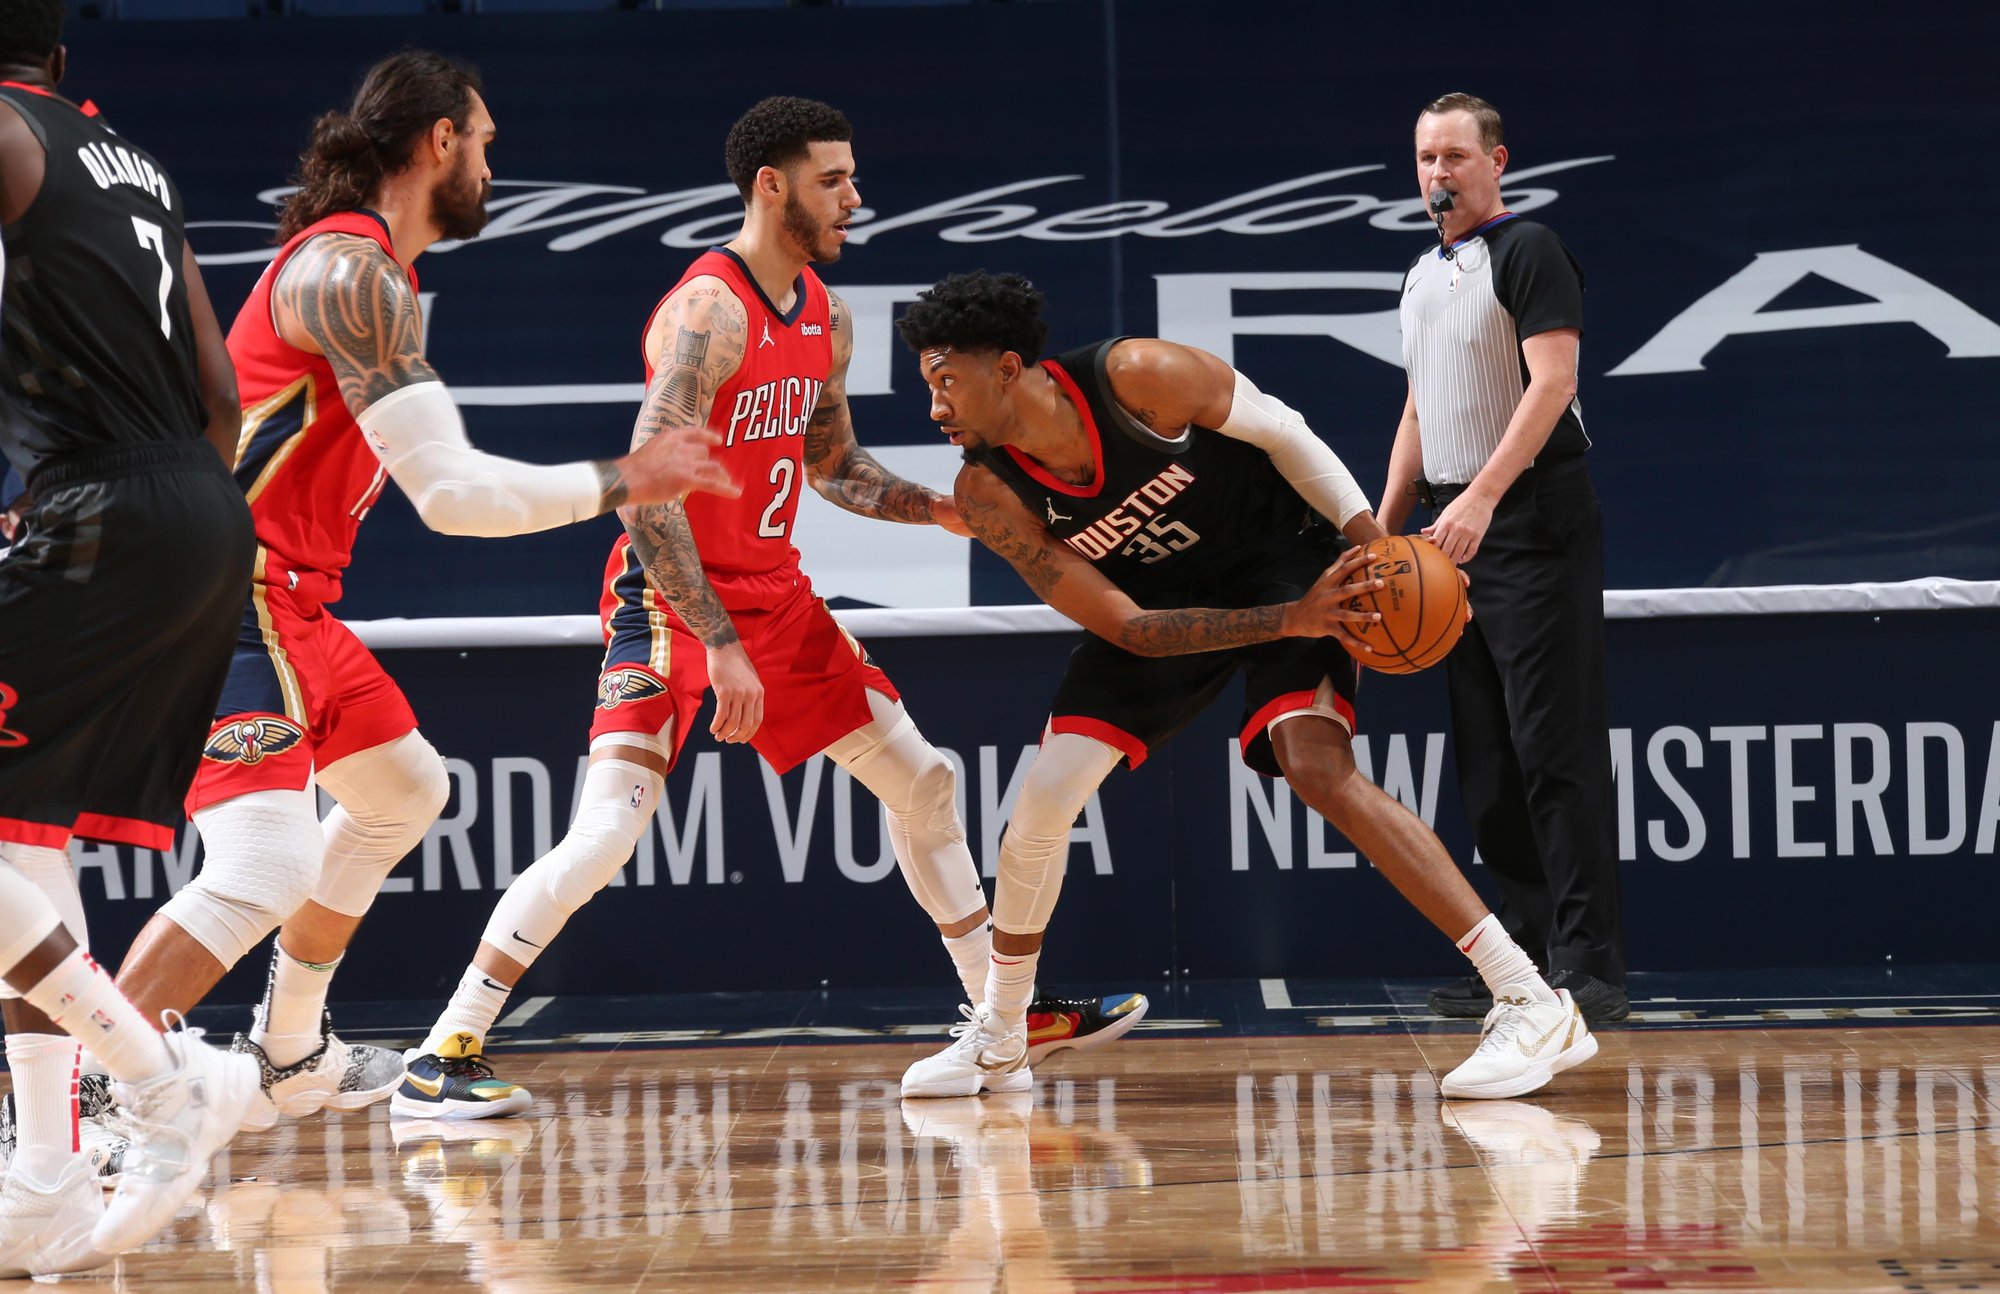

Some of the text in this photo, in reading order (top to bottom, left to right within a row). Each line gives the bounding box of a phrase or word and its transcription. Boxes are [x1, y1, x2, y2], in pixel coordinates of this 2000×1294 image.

[78, 142, 171, 211] OLADIPO
[131, 215, 173, 340] 7
[800, 322, 822, 336] ibotta
[757, 456, 796, 538] 2
[1120, 513, 1201, 565] 35
